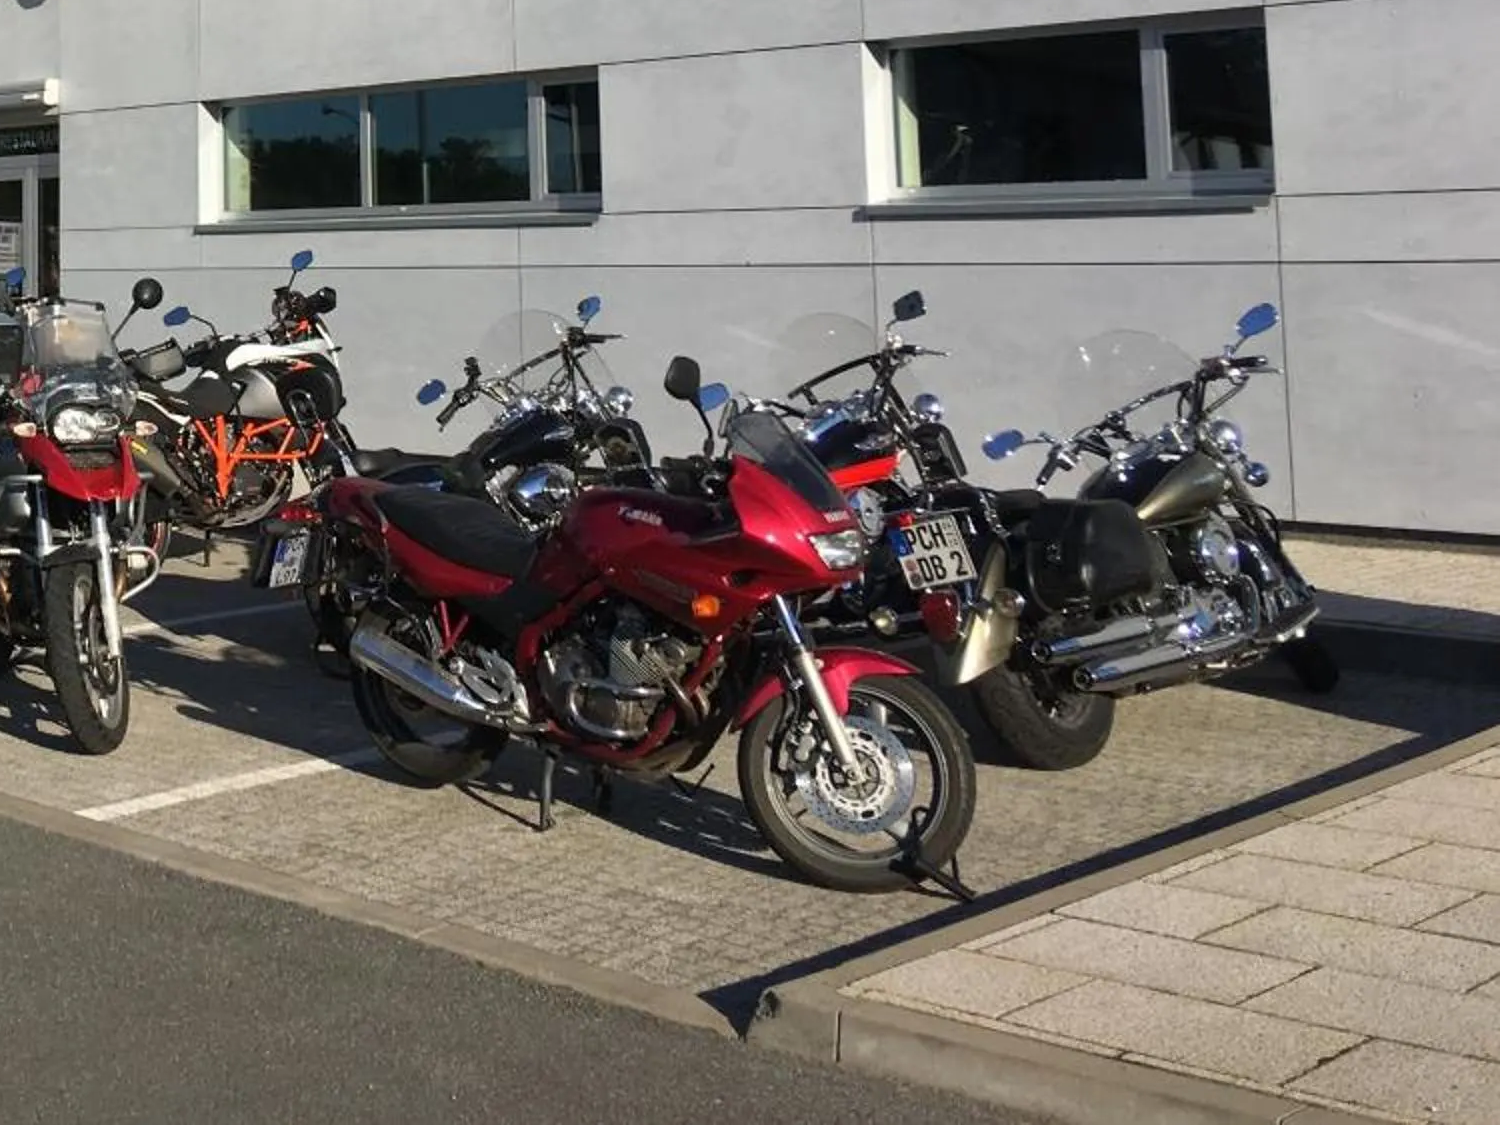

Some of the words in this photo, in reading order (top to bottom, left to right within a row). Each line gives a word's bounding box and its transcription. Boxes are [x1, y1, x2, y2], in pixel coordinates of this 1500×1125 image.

[903, 523, 948, 553] PCH
[917, 555, 947, 581] DB
[950, 550, 968, 576] 2
